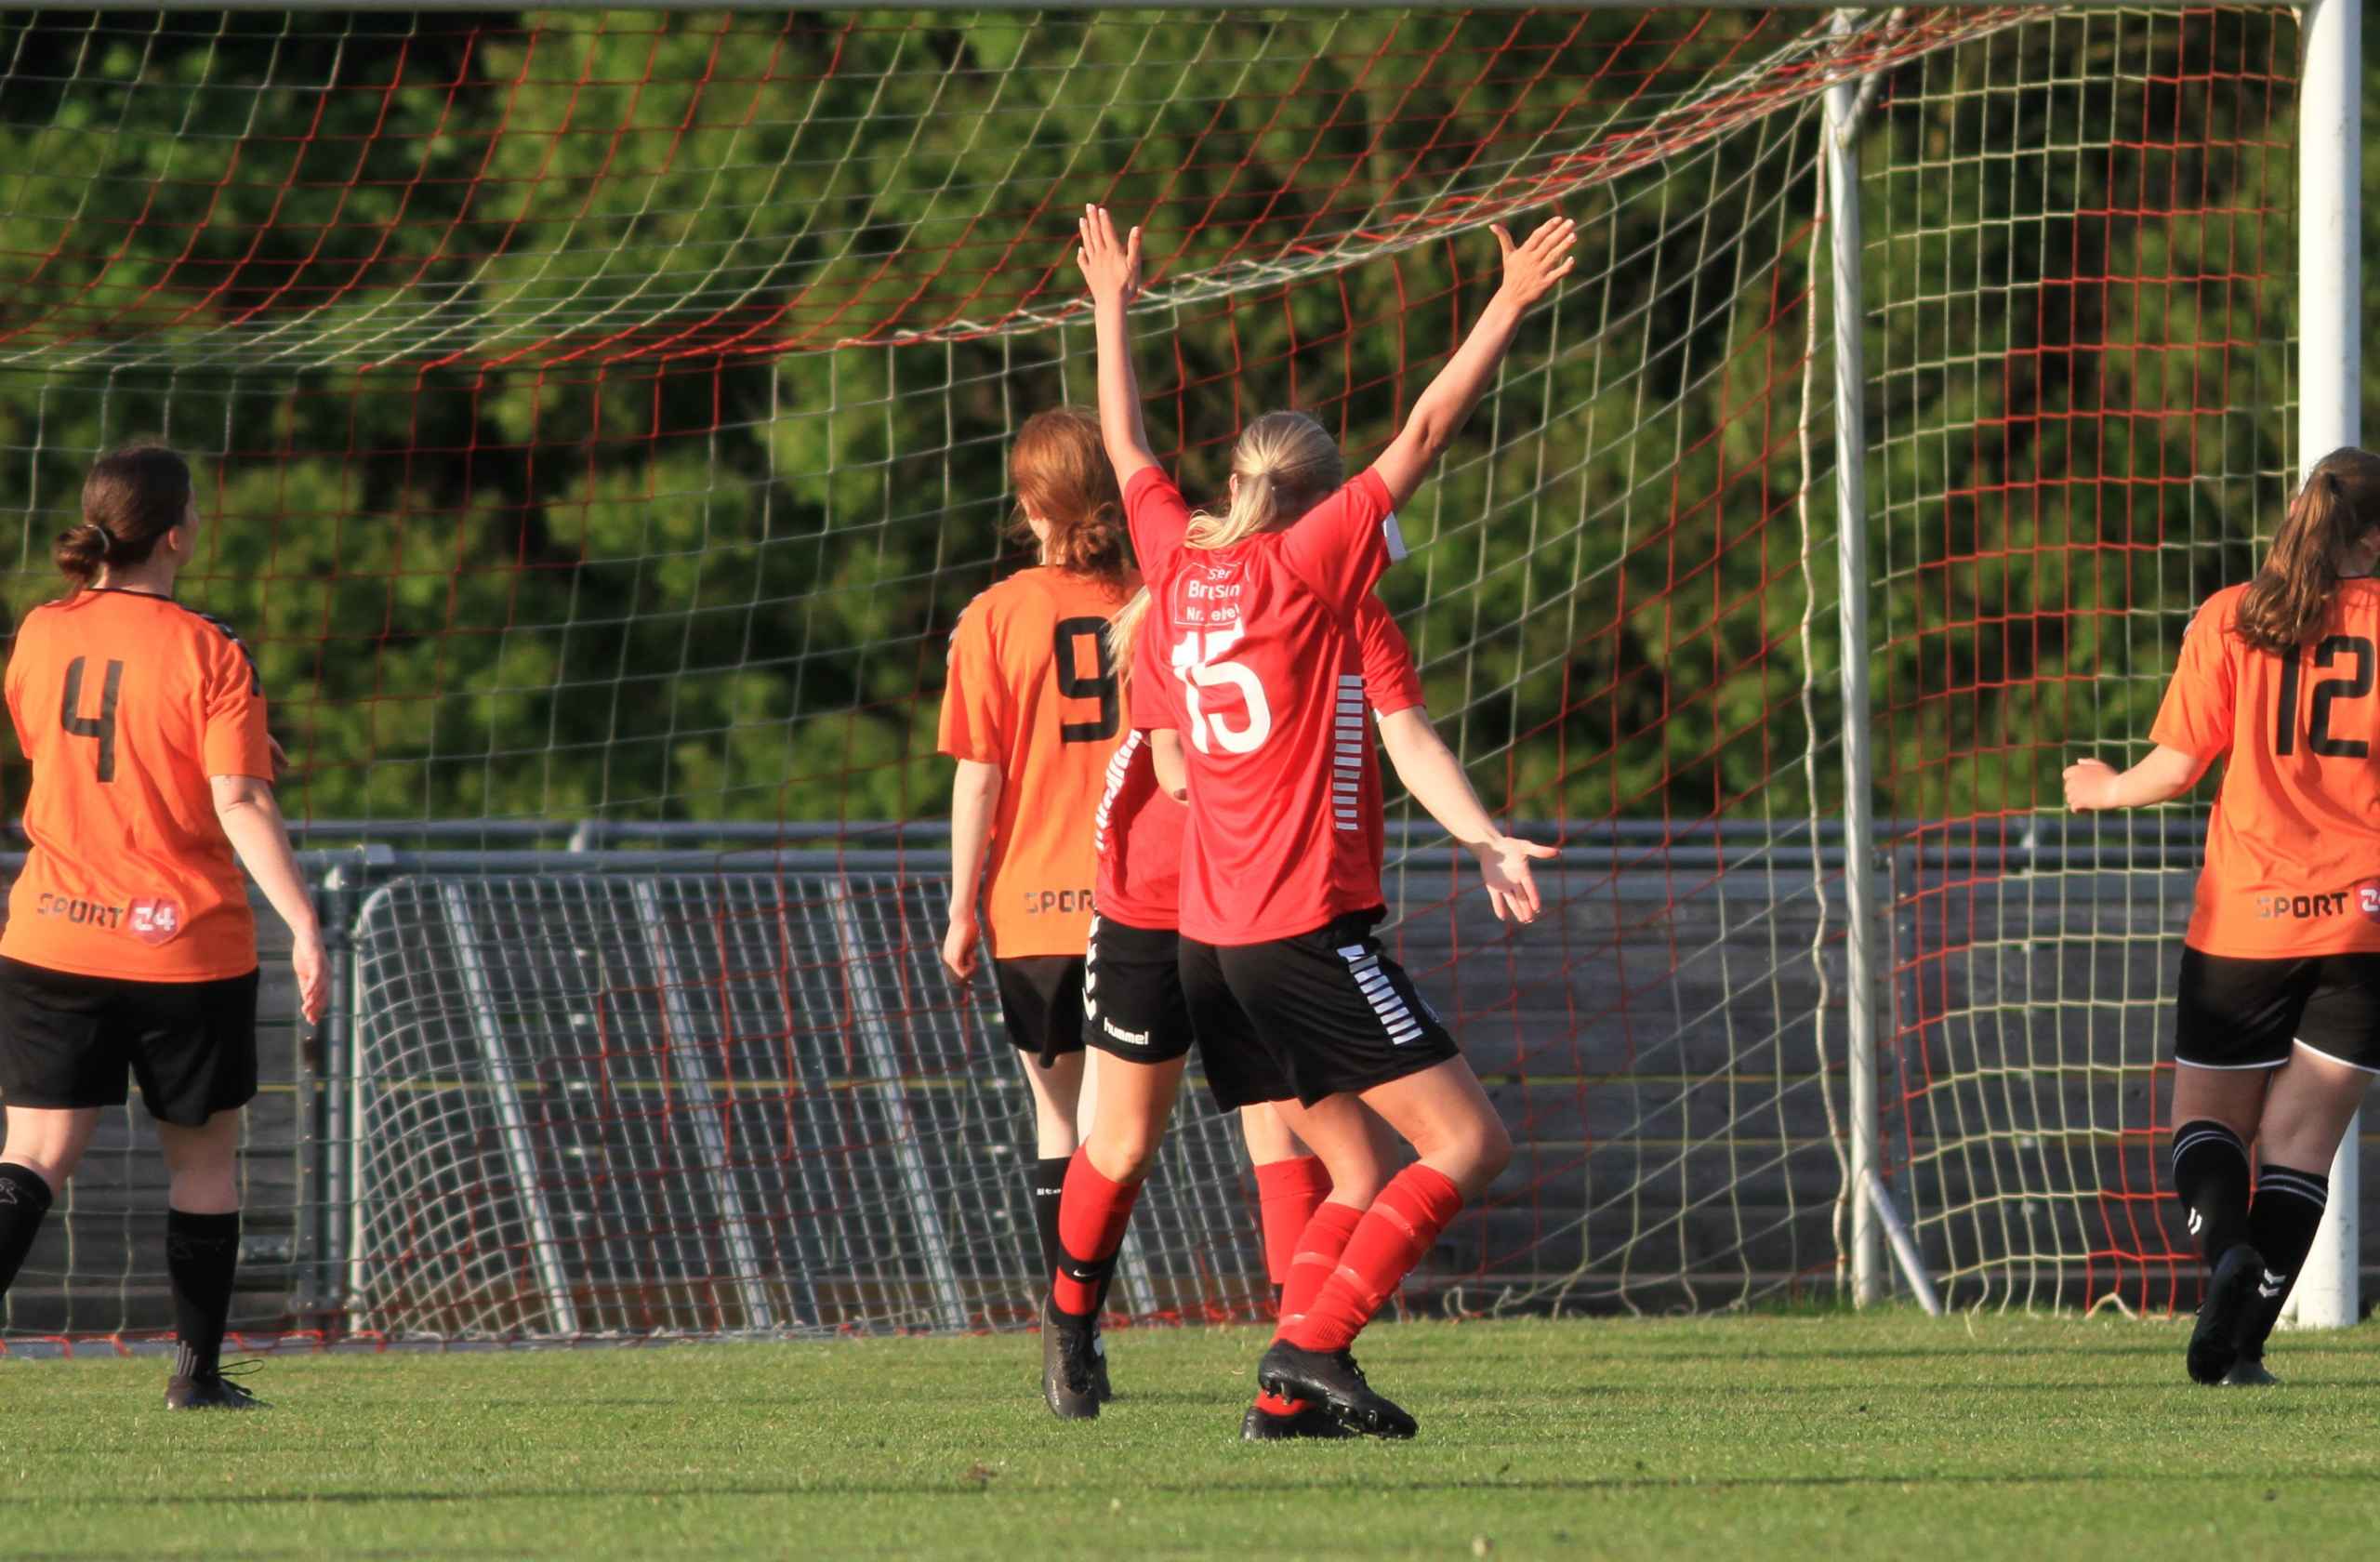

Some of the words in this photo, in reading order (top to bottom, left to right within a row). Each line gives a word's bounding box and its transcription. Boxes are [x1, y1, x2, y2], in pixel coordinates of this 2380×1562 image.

[1186, 606, 1205, 621] Nr.
[1053, 616, 1119, 743] 9
[1171, 617, 1272, 754] 15
[2276, 635, 2375, 759] 12
[60, 655, 125, 783] 4
[37, 893, 124, 929] SPORT
[134, 907, 175, 931] 24
[1025, 889, 1095, 914] SPOR
[2256, 892, 2348, 919] SPORT
[2360, 888, 2380, 911] 2
[1104, 1016, 1149, 1045] hummel
